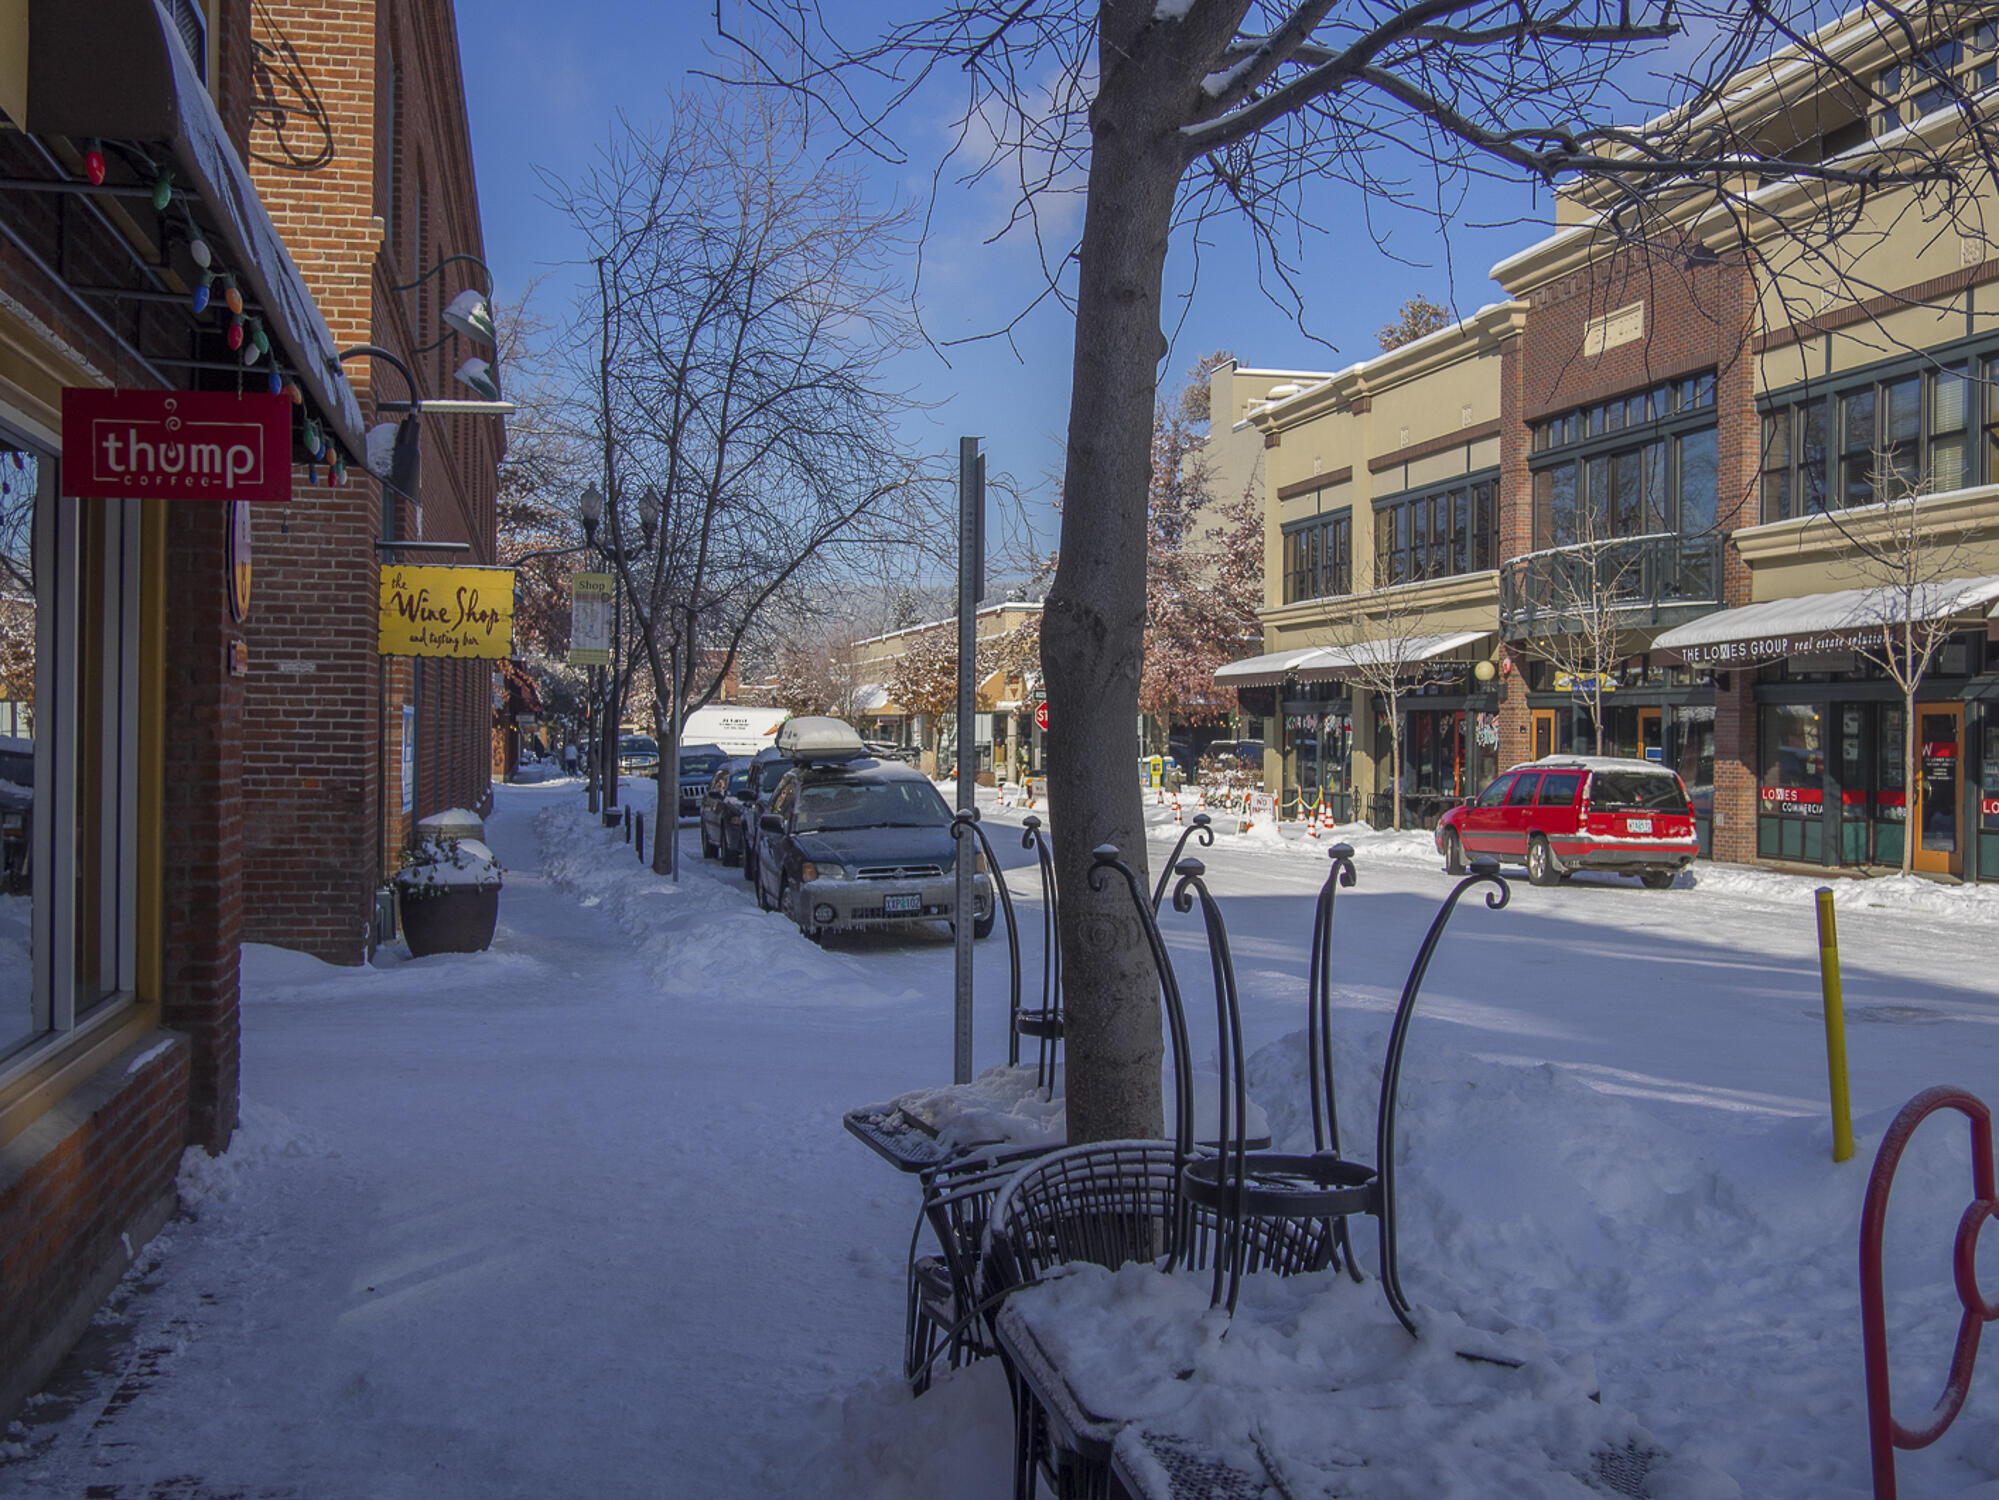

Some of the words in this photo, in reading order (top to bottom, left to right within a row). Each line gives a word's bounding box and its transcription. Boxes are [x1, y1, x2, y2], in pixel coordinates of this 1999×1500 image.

[102, 428, 255, 488] thump
[391, 572, 408, 590] the
[579, 581, 606, 592] Shop
[390, 588, 451, 623] Wine
[451, 586, 500, 636] Shop
[409, 626, 428, 647] and
[1682, 648, 1700, 661] THE
[1704, 643, 1747, 660] LOWES
[1751, 638, 1788, 655] GROUP
[1794, 636, 1813, 650] real
[1816, 638, 1844, 649] estate
[1762, 788, 1798, 801] LOWES
[1782, 802, 1823, 814] COMMERCIA
[1983, 801, 1999, 814] LO
